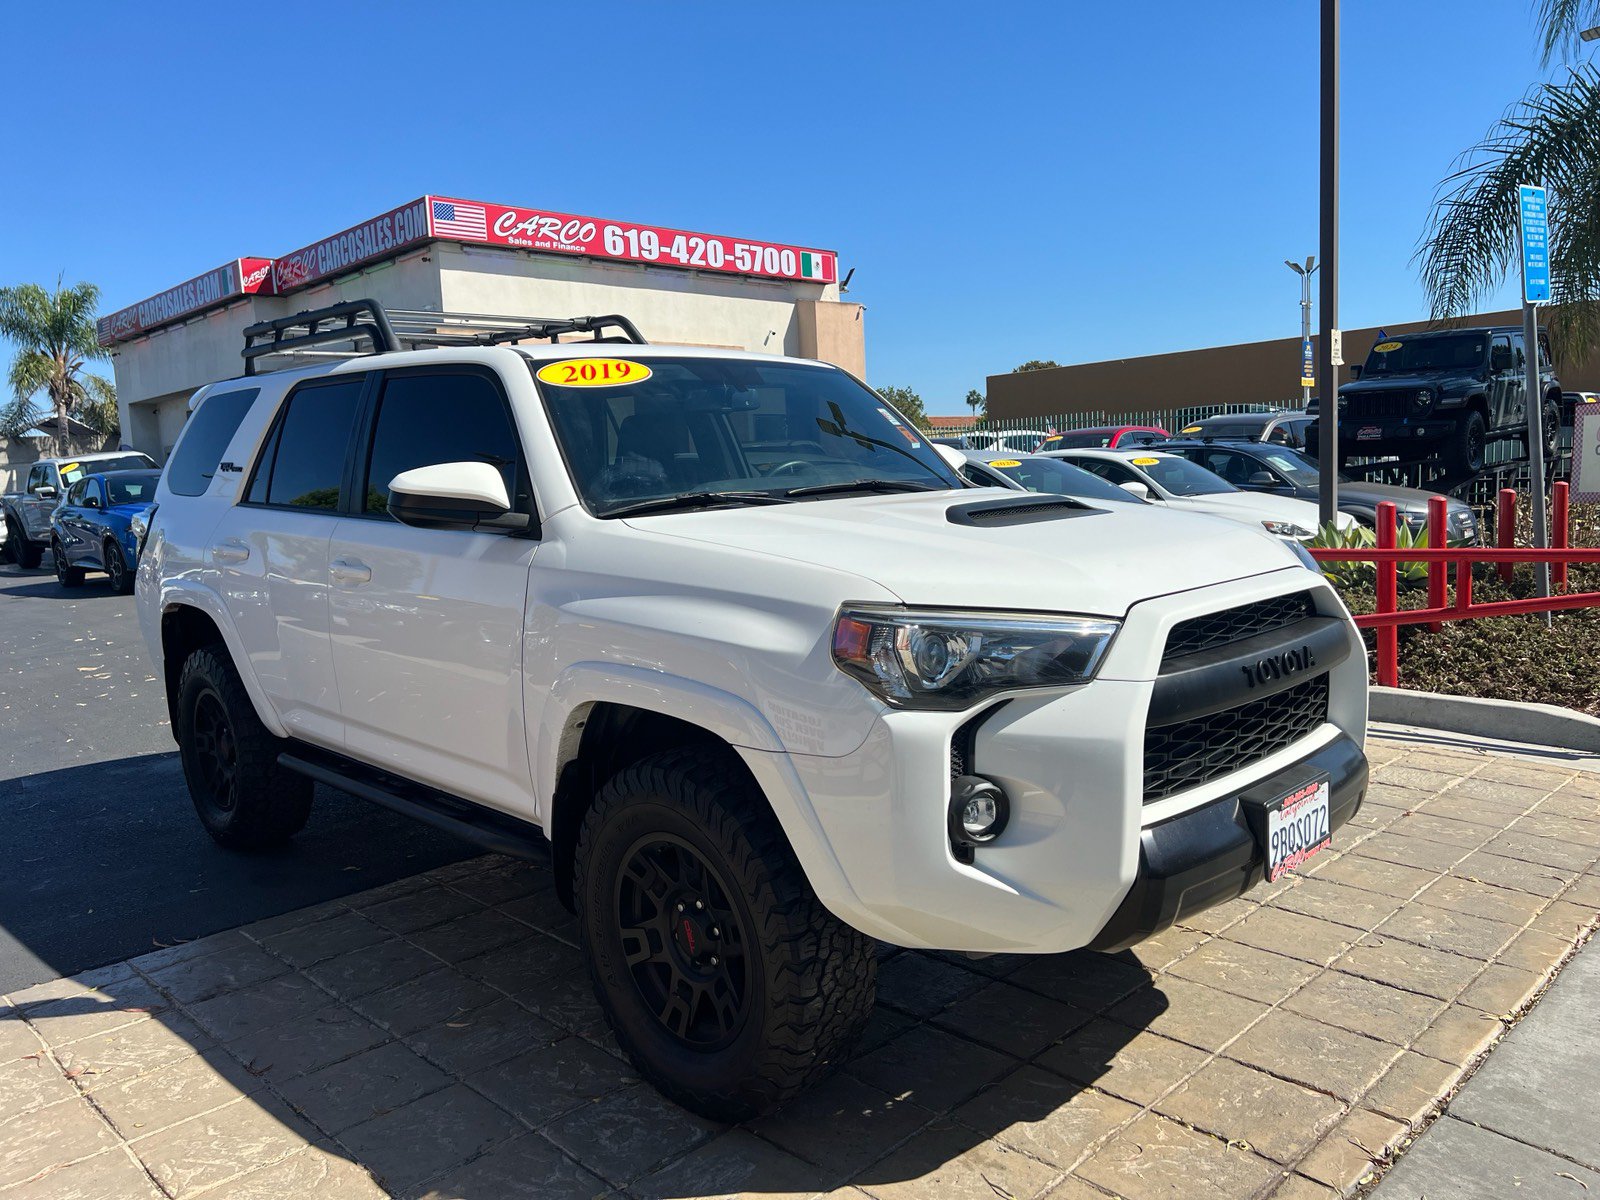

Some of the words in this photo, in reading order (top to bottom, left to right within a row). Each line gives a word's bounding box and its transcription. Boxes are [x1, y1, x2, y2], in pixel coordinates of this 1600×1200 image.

[317, 202, 427, 275] CARCOSALES.COM
[493, 211, 597, 244] CARCO
[508, 236, 533, 246] Sales
[535, 240, 551, 248] and
[553, 242, 586, 252] Finance
[277, 249, 316, 286] CARCO
[603, 225, 797, 277] 619-420-5700
[138, 272, 220, 328] CARCOSALES.COM
[562, 363, 631, 383] 2019
[1241, 645, 1316, 688] TOYOTA
[1271, 804, 1327, 868] 9BQS072
